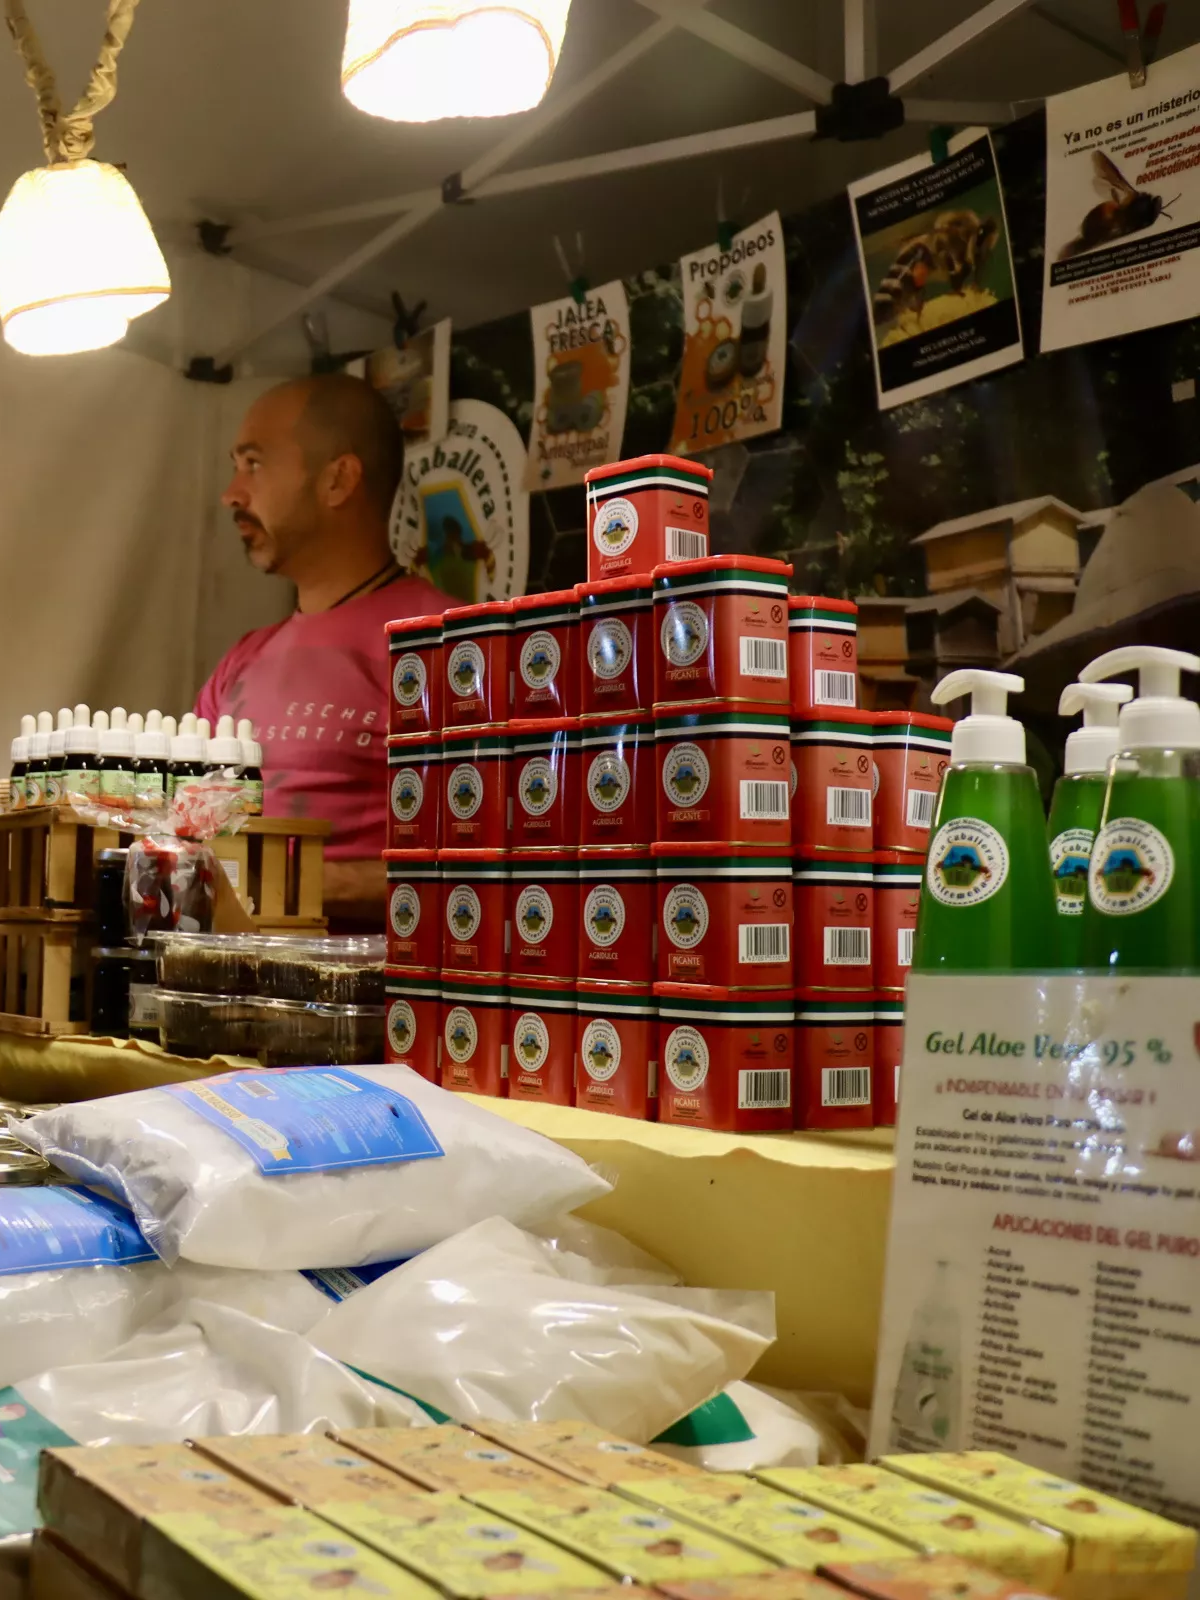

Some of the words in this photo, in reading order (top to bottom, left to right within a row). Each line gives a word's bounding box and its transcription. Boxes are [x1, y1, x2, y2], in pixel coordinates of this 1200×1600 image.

[1064, 131, 1080, 144] Ya
[1085, 125, 1102, 139] no
[1106, 120, 1122, 132] es
[1126, 112, 1143, 126] un
[1147, 90, 1200, 118] misterio
[555, 297, 608, 329] JALEA
[550, 320, 613, 351] FRESCA
[408, 443, 496, 520] Caballera
[600, 558, 632, 571] AGRIDULCE
[670, 670, 700, 680] PICANTE
[286, 702, 389, 729] ESCHE
[251, 725, 390, 747] USCATIO
[672, 810, 702, 820] PICANTE
[947, 832, 994, 862] Caballera
[520, 948, 547, 957] AGRIDULCE
[588, 951, 619, 960] AGRIDULCE
[673, 956, 701, 966] PICANTE
[925, 1031, 964, 1054] Gel
[969, 1032, 1026, 1057] Aloe
[1034, 1034, 1095, 1060] Ver
[1103, 1039, 1136, 1067] 95
[1146, 1038, 1173, 1064] %
[517, 1074, 543, 1086] AGRIDULCE
[586, 1084, 615, 1096] AGRIDULCE
[673, 1097, 701, 1108] PICANTE
[962, 1108, 978, 1121] Gel
[981, 1110, 992, 1122] de
[995, 1110, 1017, 1124] Aloe
[944, 1161, 959, 1173] Gel
[992, 1213, 1092, 1242] APLICACIONES
[1096, 1225, 1121, 1247] DEL
[1124, 1229, 1153, 1251] GEL
